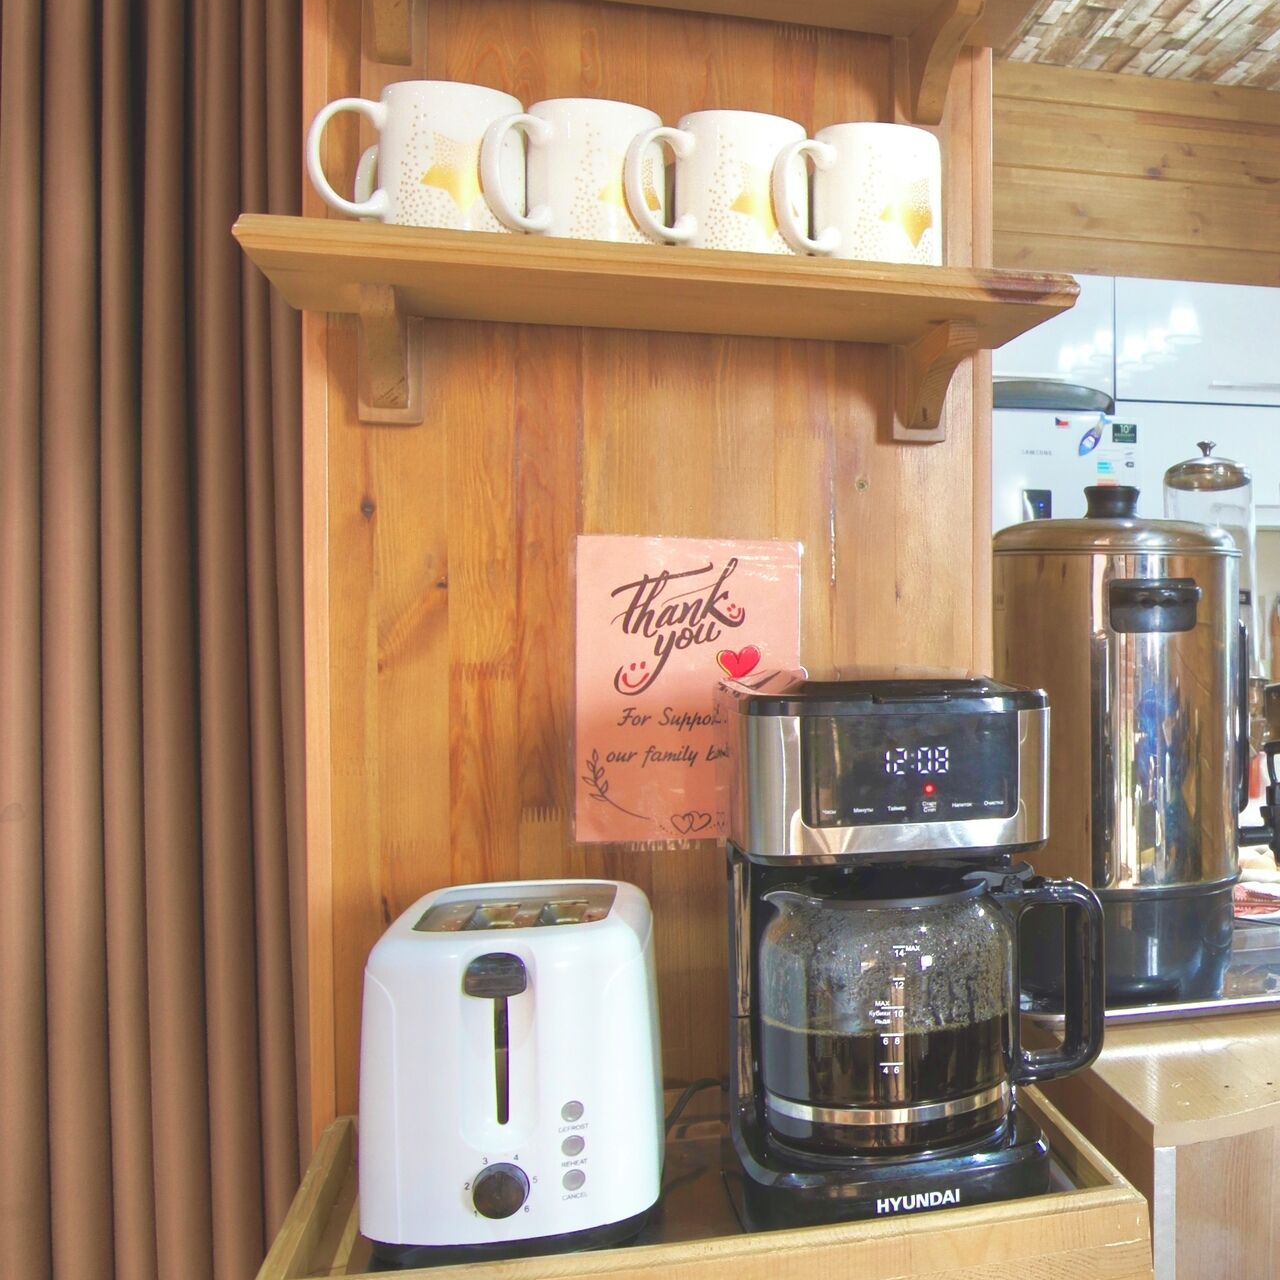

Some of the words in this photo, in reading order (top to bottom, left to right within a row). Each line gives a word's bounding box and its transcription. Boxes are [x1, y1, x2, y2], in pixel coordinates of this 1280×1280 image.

[611, 558, 745, 637] Thank
[614, 621, 721, 696] you
[617, 707, 652, 726] For
[606, 751, 638, 763] our
[641, 745, 699, 768] family
[886, 746, 949, 775] 12:08
[895, 949, 905, 957] 14
[895, 981, 904, 989] 12
[882, 1037, 889, 1045] 6
[894, 1037, 900, 1045] 8
[882, 1066, 889, 1074] 4
[893, 1066, 900, 1074] 6
[558, 1123, 589, 1133] DEFROST
[561, 1158, 588, 1168] REHEAT
[561, 1191, 588, 1201] CANCEL
[876, 1188, 960, 1214] HYUNDAI
